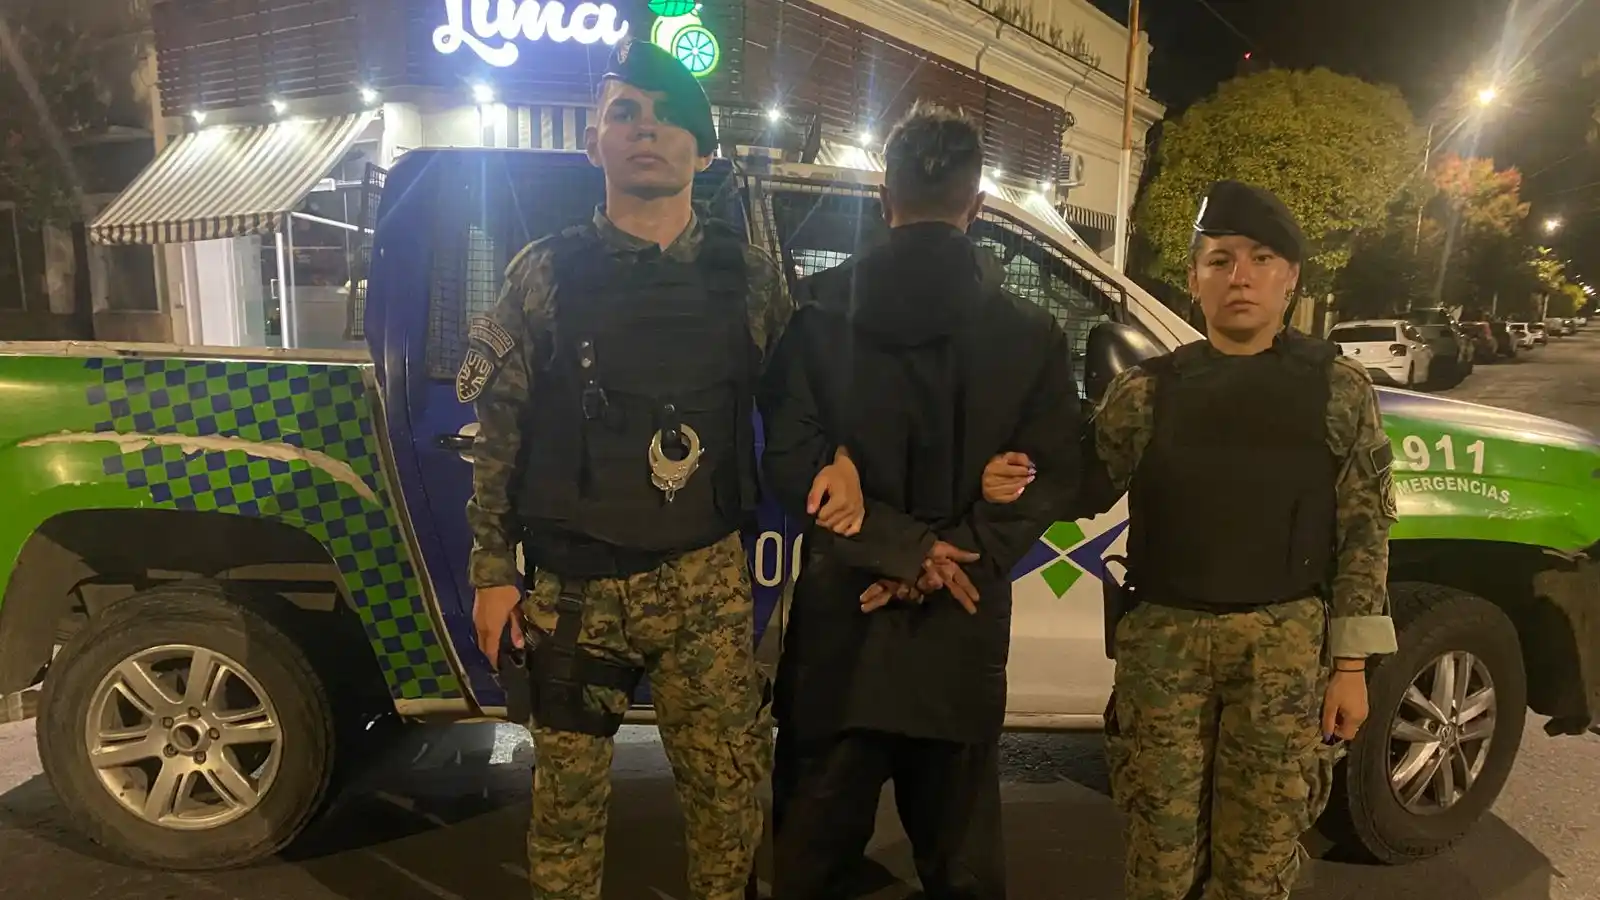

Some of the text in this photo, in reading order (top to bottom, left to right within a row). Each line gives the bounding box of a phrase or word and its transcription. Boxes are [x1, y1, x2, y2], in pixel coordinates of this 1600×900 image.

[432, 0, 629, 67] Lima
[1402, 434, 1485, 475] 911
[1396, 477, 1511, 504] MERGENCIAS
